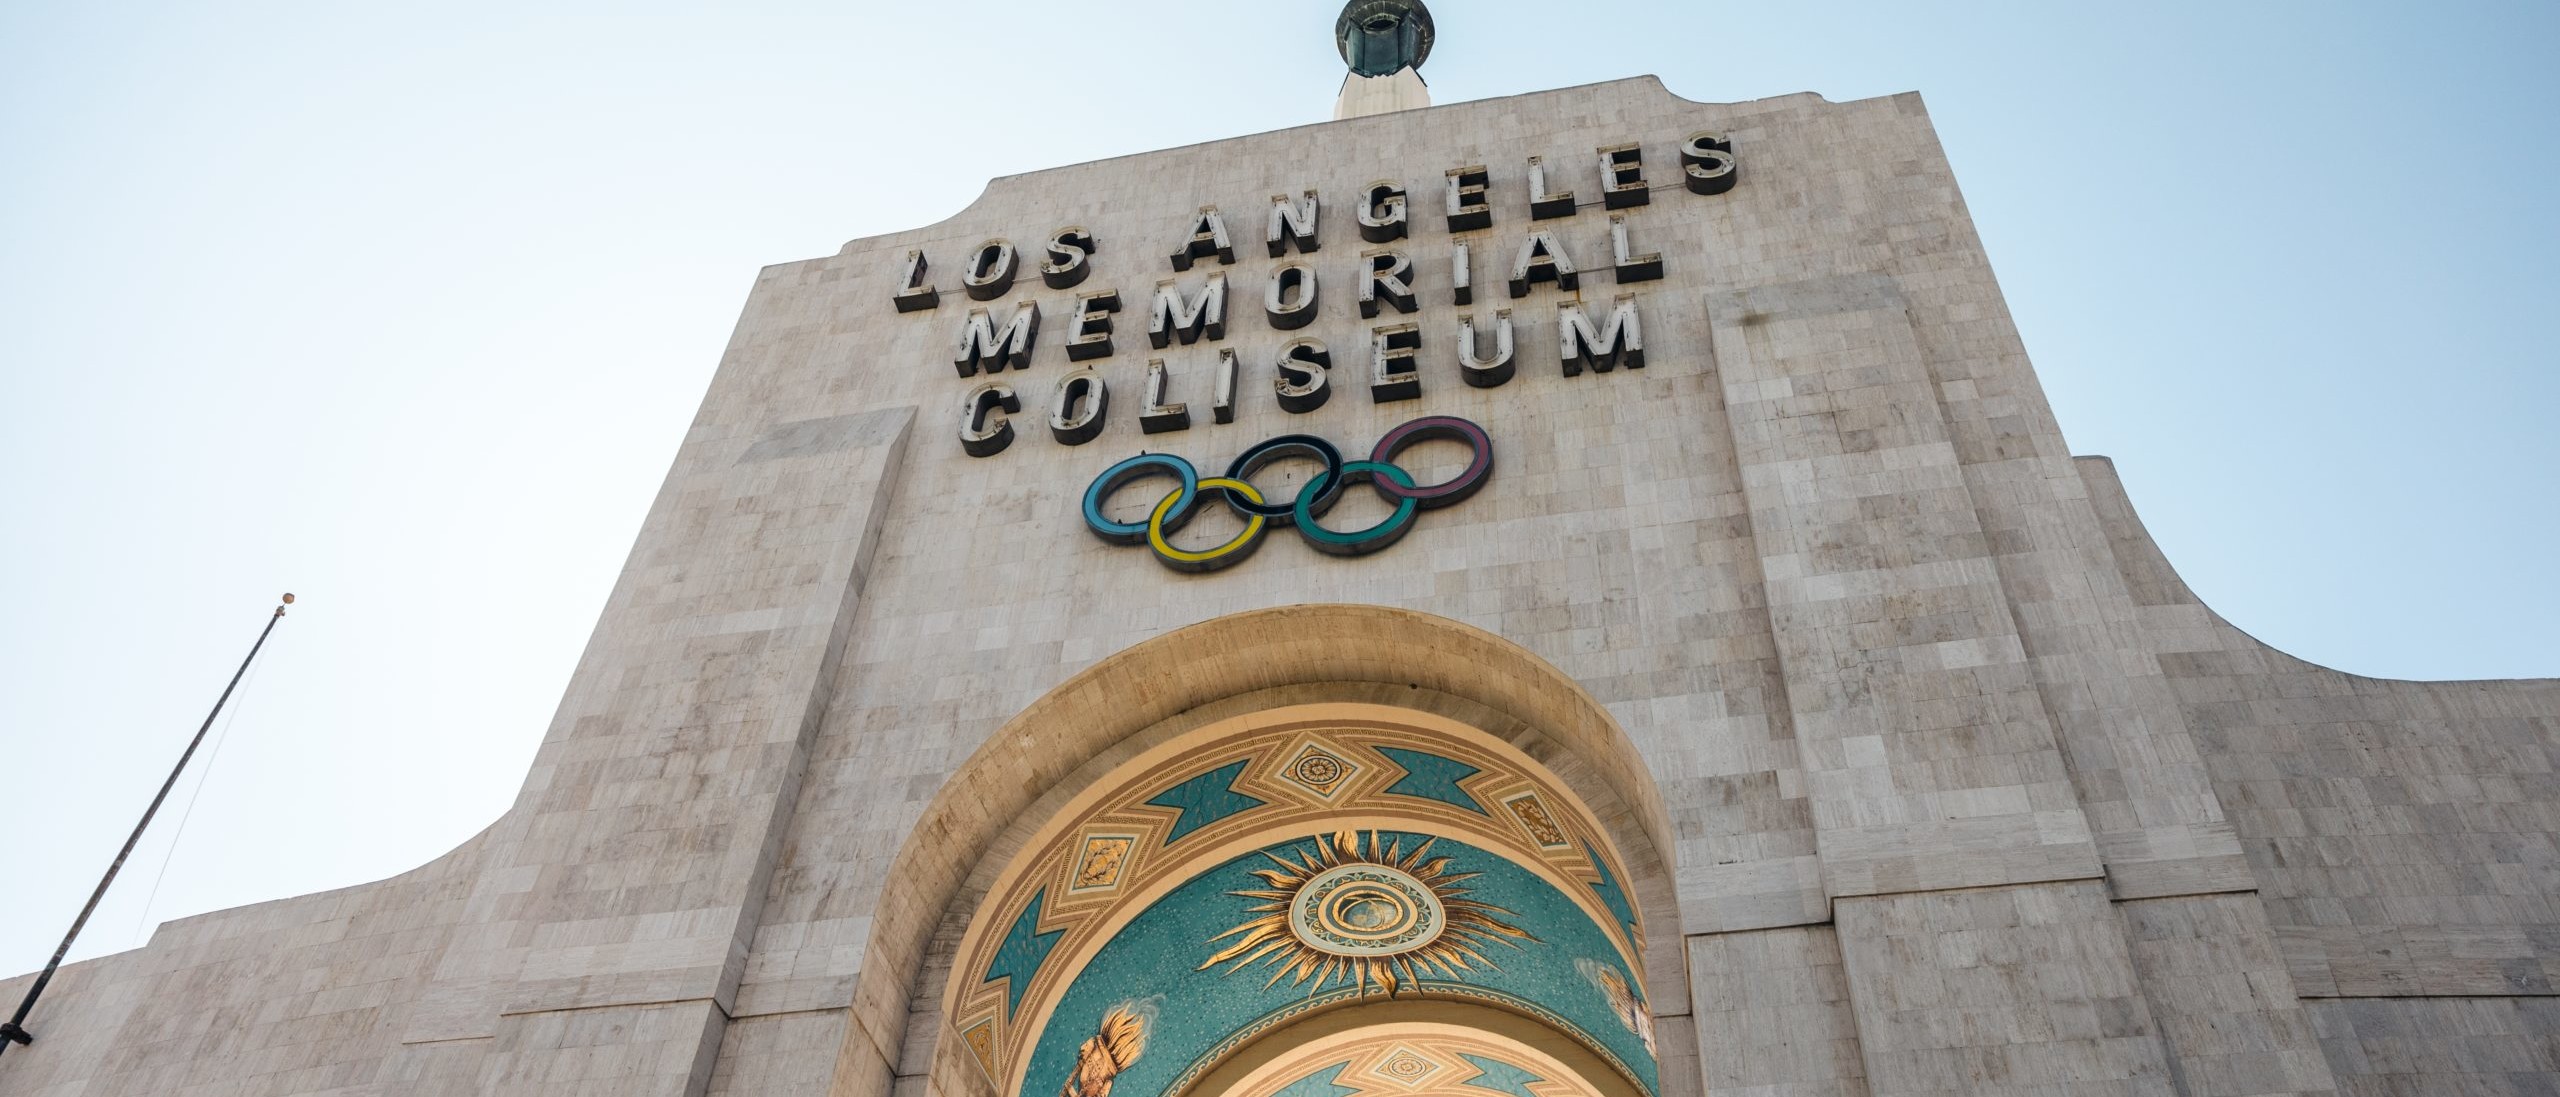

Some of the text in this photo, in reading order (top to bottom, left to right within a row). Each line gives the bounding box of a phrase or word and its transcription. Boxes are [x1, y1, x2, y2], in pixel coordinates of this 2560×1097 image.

[893, 130, 1737, 313] LOS ANGELES
[954, 215, 1664, 378] MEMORIAL
[957, 292, 1645, 457] COLISEUM
